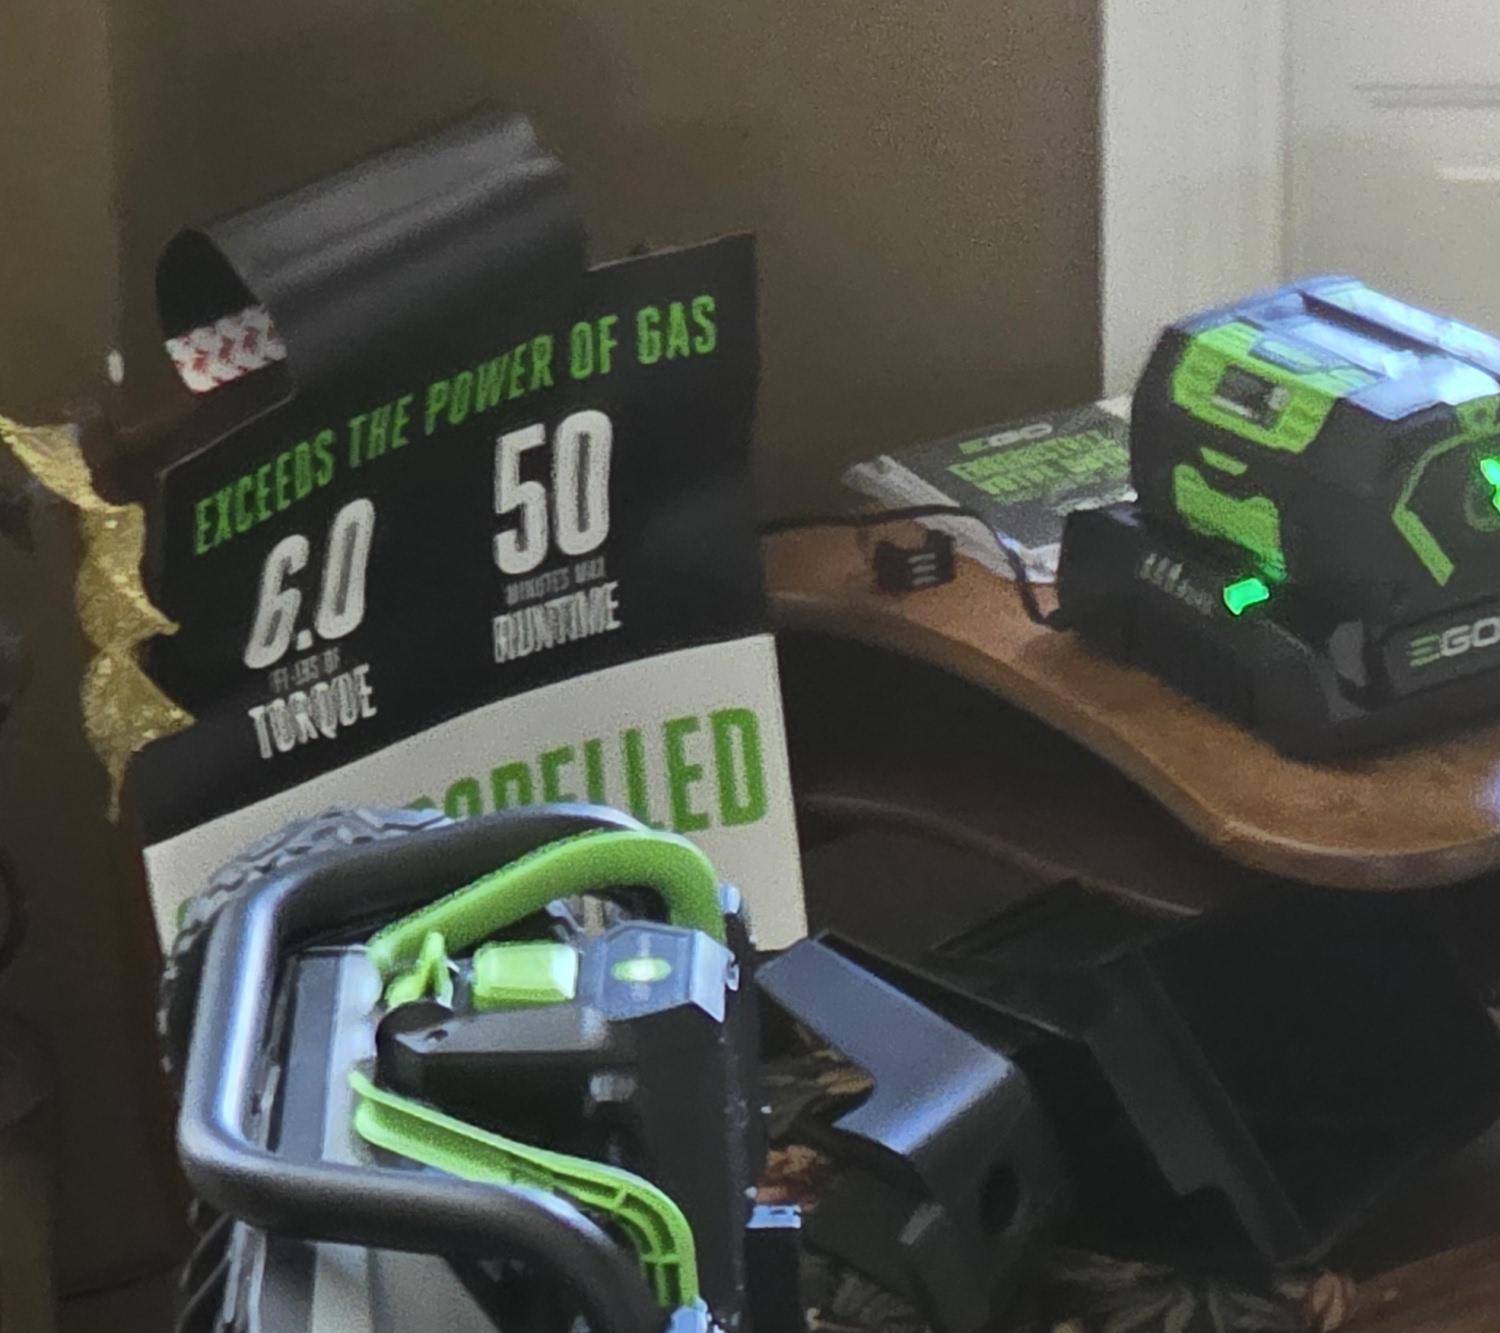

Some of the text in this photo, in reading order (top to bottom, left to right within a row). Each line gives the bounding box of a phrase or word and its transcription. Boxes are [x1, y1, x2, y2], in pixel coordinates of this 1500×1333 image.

[194, 294, 717, 555] EXCEEDS THE POWER OF GAS
[493, 409, 613, 574] 50
[243, 498, 376, 669] 6.0
[493, 580, 622, 663] RUNTIME
[247, 662, 378, 759] TORQUE
